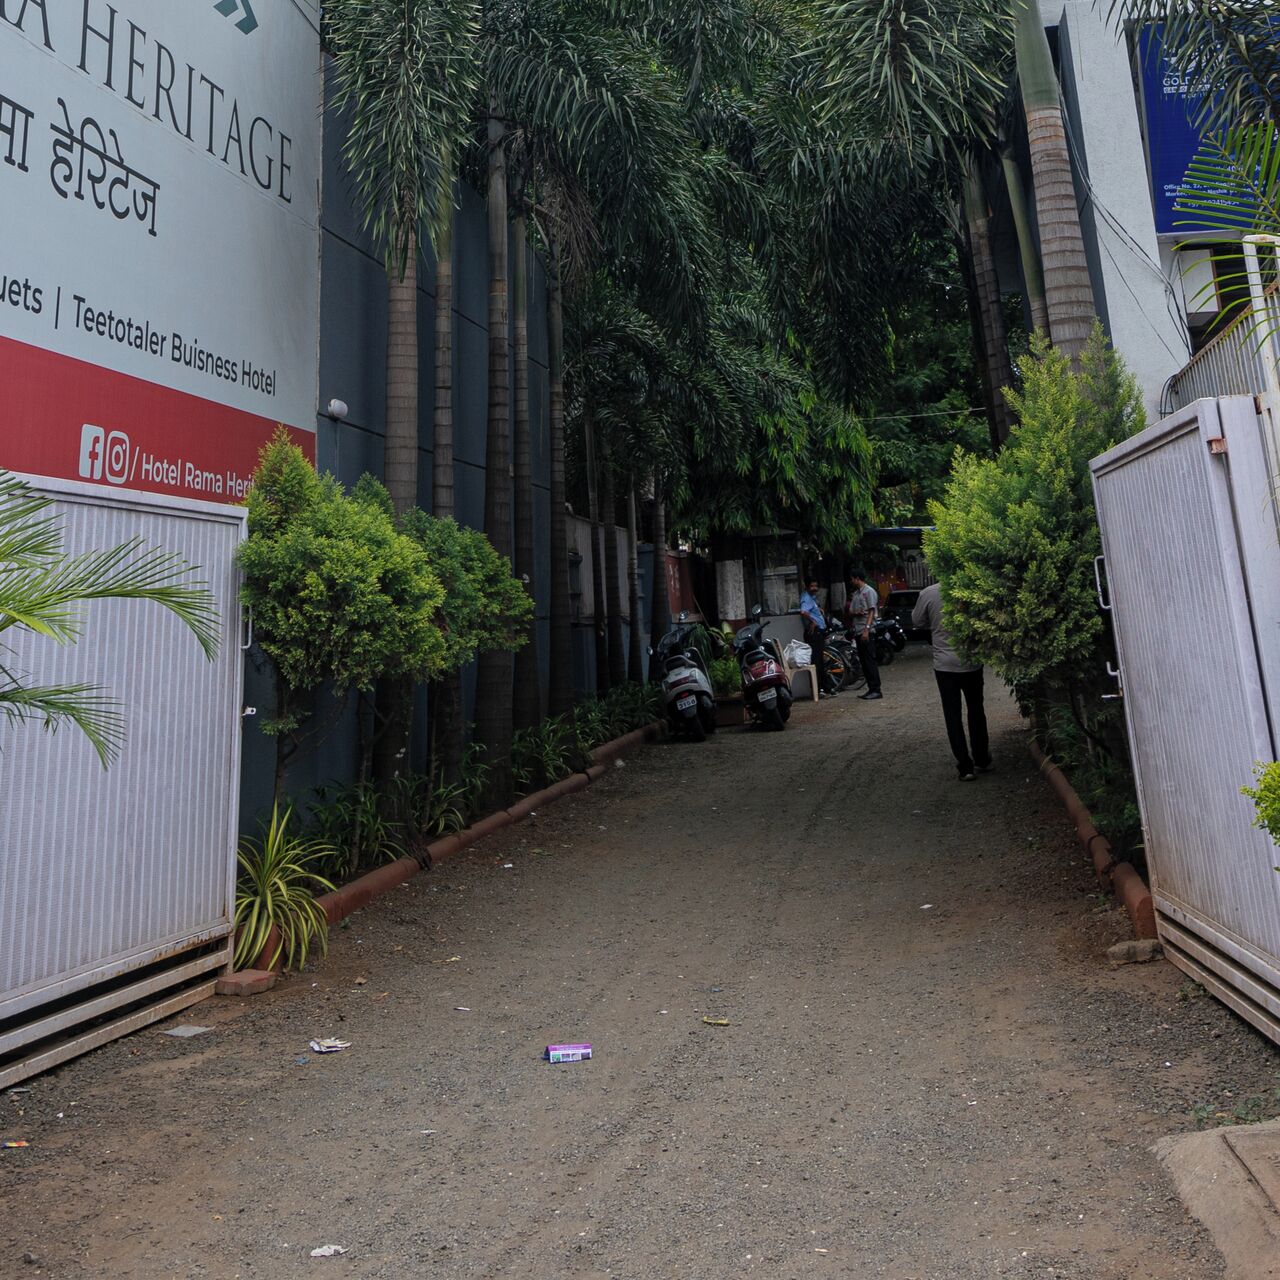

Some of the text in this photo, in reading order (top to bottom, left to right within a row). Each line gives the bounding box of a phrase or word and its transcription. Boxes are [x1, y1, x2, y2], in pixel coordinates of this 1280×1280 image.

[49, 98, 161, 237] हेरिटेज
[72, 294, 167, 358] Teetotaler
[171, 332, 238, 383] Buisness
[241, 360, 277, 397] Hotel
[142, 453, 181, 487] Hotel
[185, 463, 223, 494] Rama
